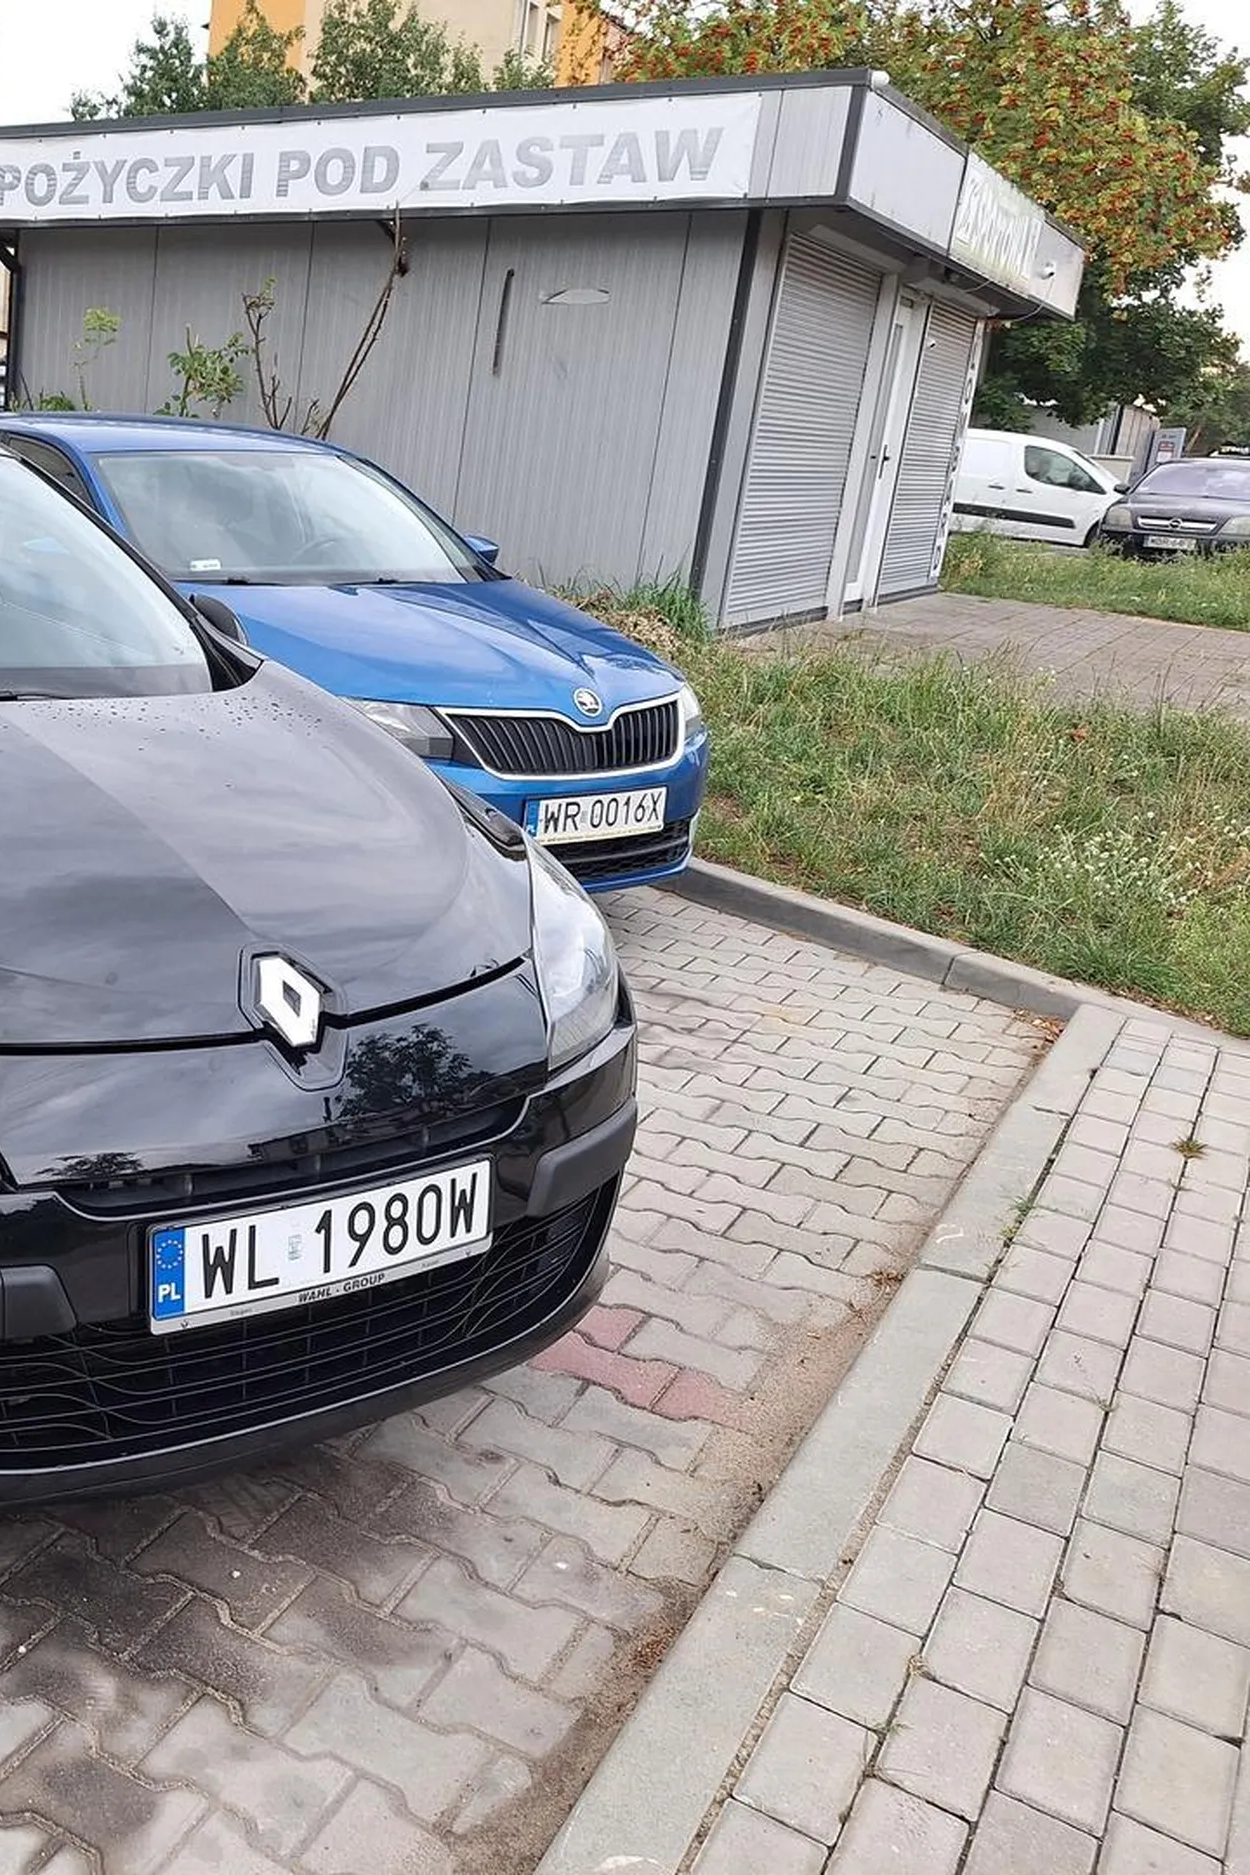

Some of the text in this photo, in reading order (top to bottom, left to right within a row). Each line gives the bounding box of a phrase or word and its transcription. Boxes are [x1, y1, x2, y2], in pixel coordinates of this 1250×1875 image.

[275, 144, 400, 199] POD
[419, 127, 724, 192] ZASTAW
[543, 801, 581, 834] WR
[589, 791, 663, 829] 0016X
[201, 1172, 478, 1299] WL 1980W
[157, 1283, 182, 1303] PL
[298, 1287, 332, 1302] WAHL
[342, 1272, 385, 1292] GROUP
